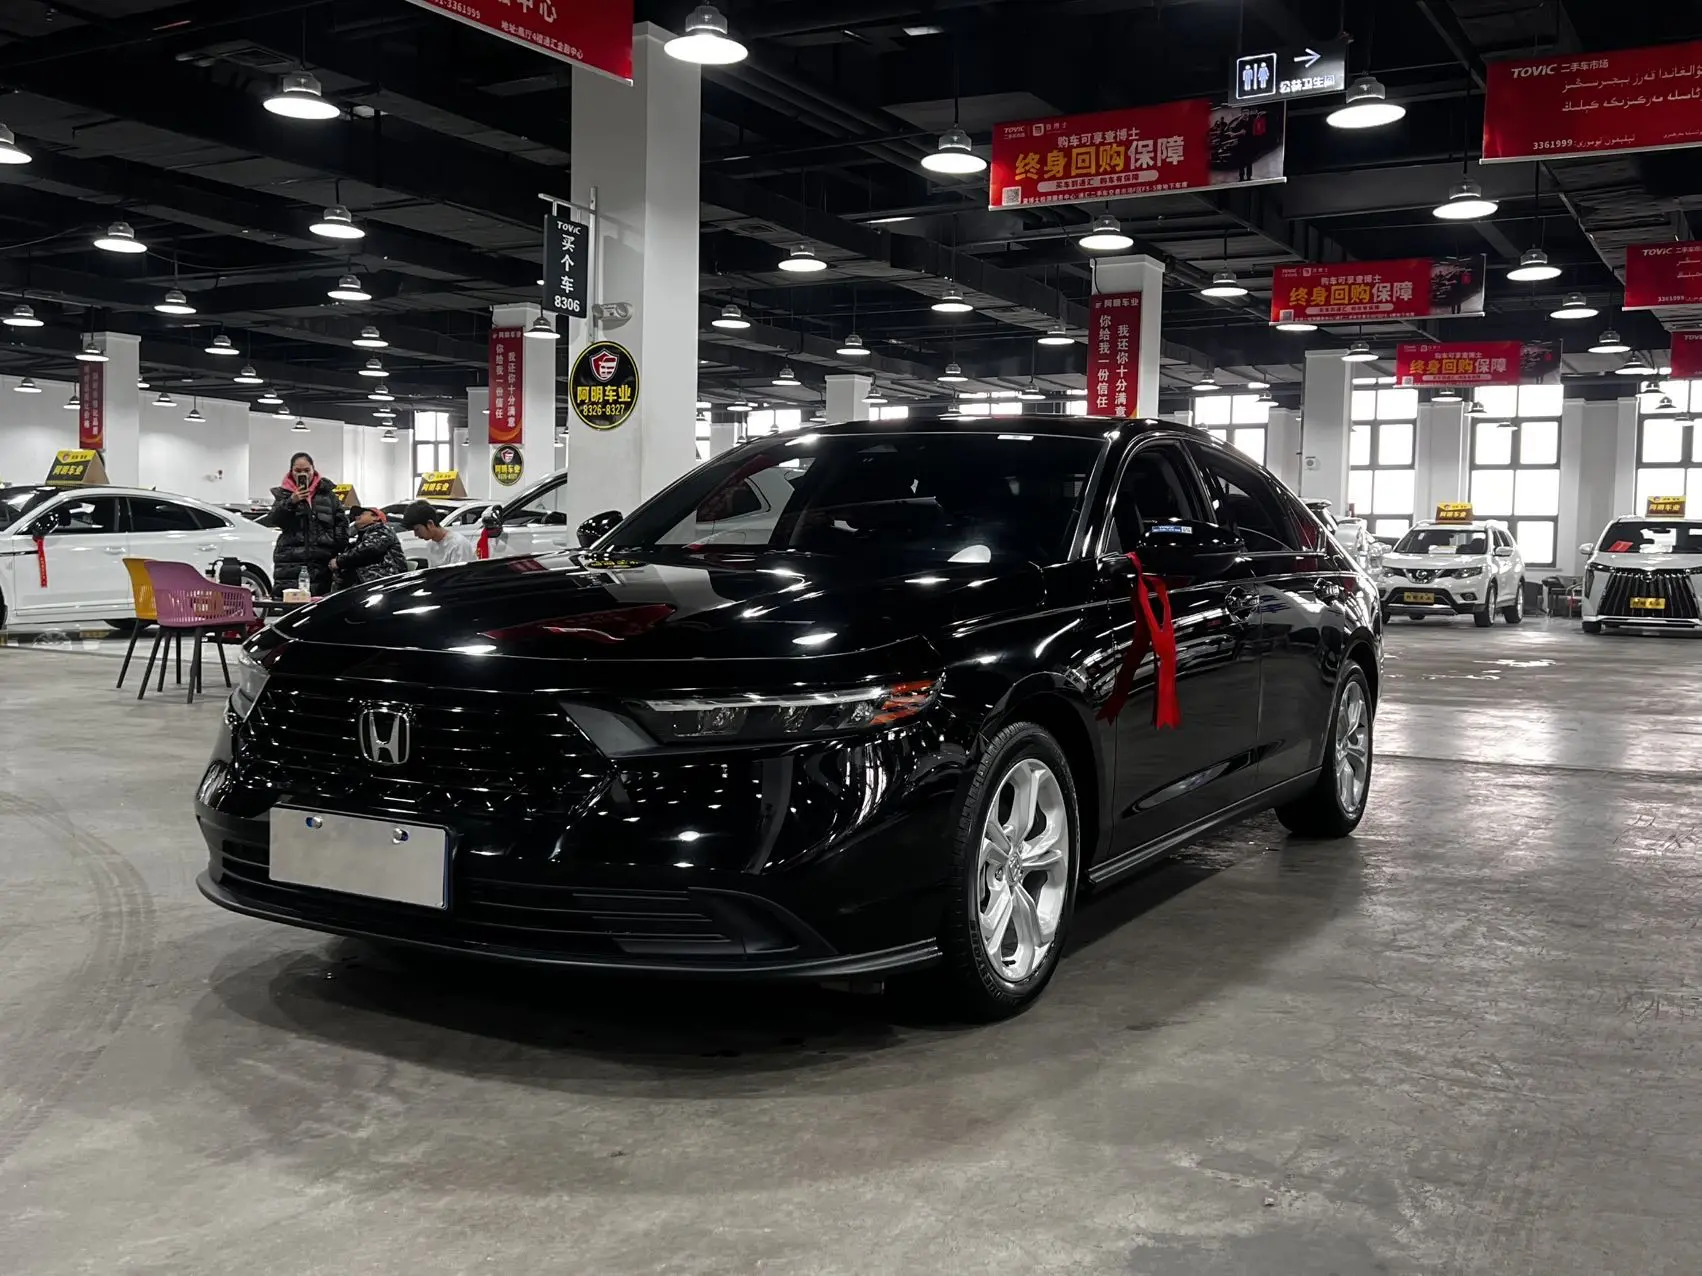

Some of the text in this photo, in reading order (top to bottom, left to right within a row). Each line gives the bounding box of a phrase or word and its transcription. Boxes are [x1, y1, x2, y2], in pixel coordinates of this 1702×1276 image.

[1057, 127, 1140, 149] 购车可享查博士
[1532, 138, 1573, 150] 3361999
[1014, 136, 1185, 181] 终身回购保障
[560, 234, 575, 294] 买个车
[554, 295, 580, 312] 8306
[1289, 282, 1413, 306] 终身回购保障
[1096, 315, 1111, 409] 你给我一份信任
[1114, 324, 1130, 417] 我还你十分满意
[1409, 358, 1507, 374] 终身回购保障
[495, 344, 505, 419] 你给我一份信任
[507, 351, 517, 428] 我还你十分满意
[577, 384, 632, 403] 阿明车业
[583, 403, 625, 416] 8326-8327
